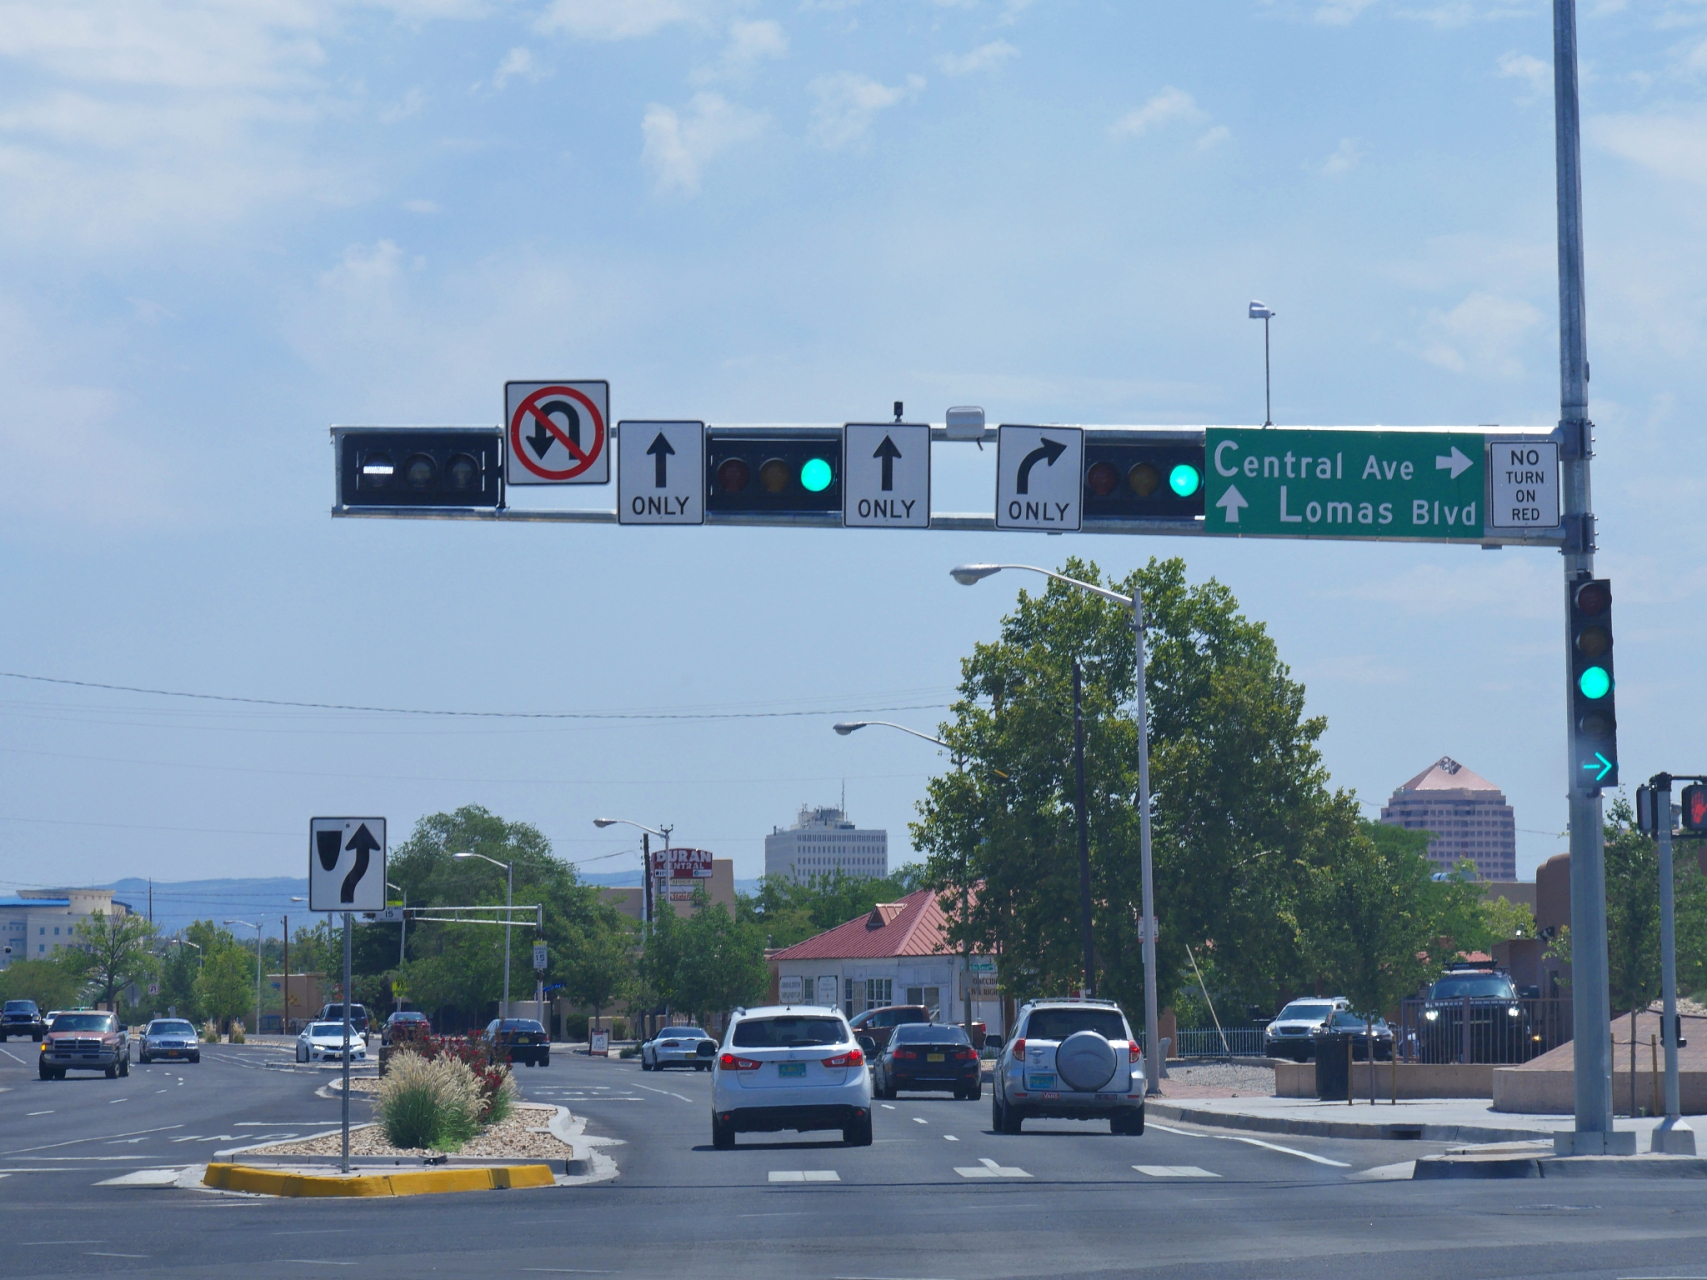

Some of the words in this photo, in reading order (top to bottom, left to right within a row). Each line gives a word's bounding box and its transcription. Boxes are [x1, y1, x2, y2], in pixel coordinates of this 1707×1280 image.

[1214, 439, 1343, 480] Central
[1361, 455, 1414, 481] Ave
[1511, 450, 1540, 466] NO
[1506, 471, 1545, 484] TURN
[1516, 489, 1536, 503] ON
[632, 496, 690, 515] ONLY
[858, 499, 916, 518] ONLY
[1009, 501, 1070, 521] ONLY
[1280, 485, 1393, 525] Lomas
[1412, 500, 1476, 526] Blvd
[1512, 508, 1540, 521] RED
[656, 850, 711, 862] DURAN
